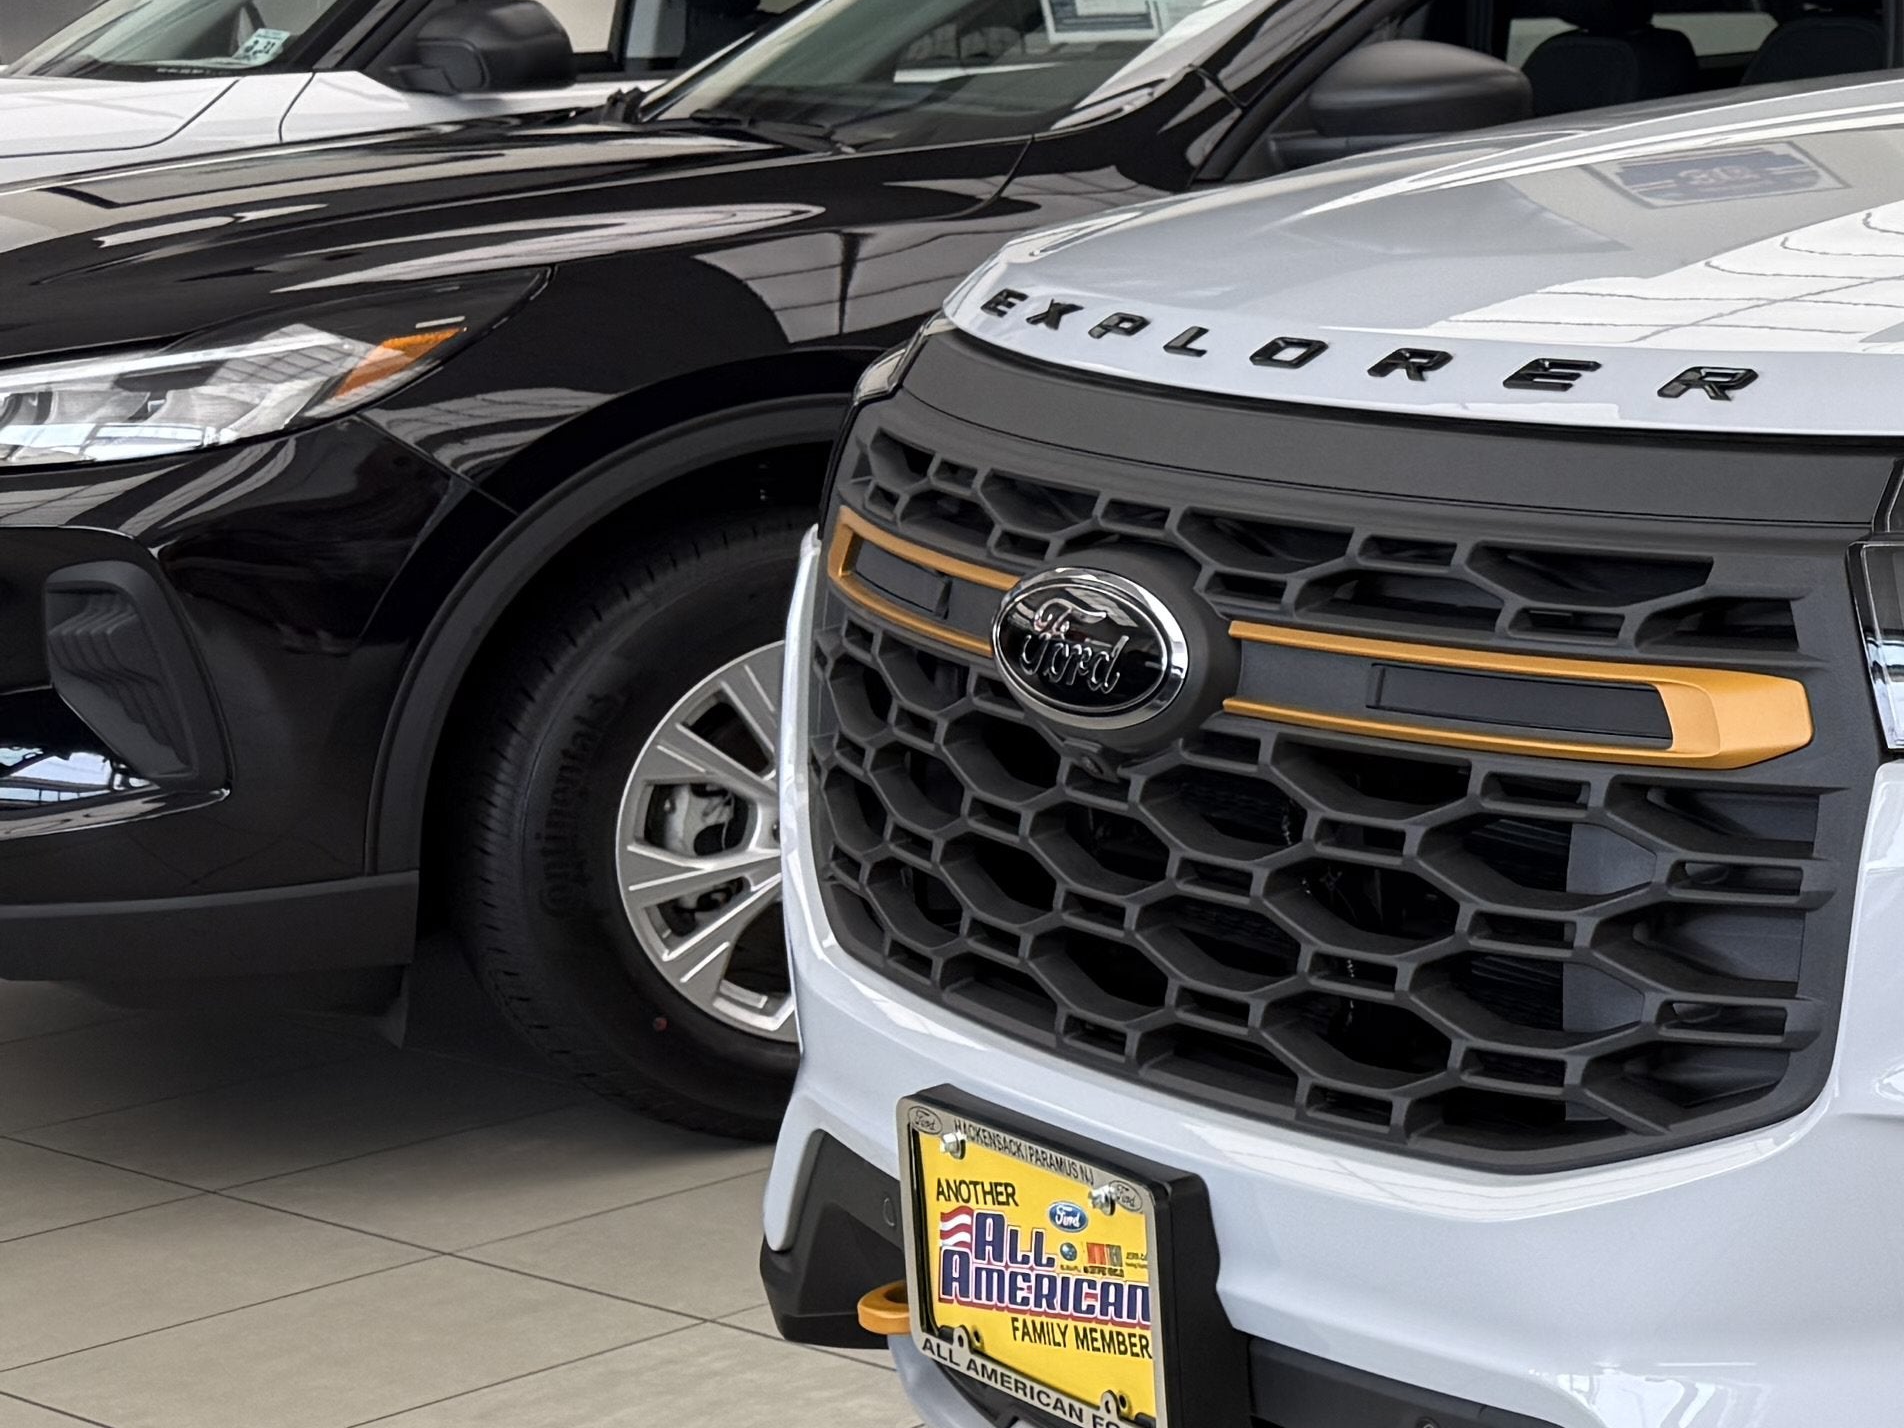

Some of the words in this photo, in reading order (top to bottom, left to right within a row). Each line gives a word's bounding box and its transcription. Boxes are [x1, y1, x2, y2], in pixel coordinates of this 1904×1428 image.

[980, 287, 1760, 403] EXPLORER
[1020, 598, 1131, 696] Ford
[936, 1177, 1019, 1207] ANOTHER
[953, 1118, 1023, 1161] HACKENSACK
[1028, 1147, 1080, 1182] PARAMUS
[1081, 1170, 1095, 1187] NJ
[940, 1246, 1152, 1326] AMERICAN
[1011, 1316, 1071, 1348] FAMILY
[1074, 1324, 1153, 1360] MEMBER
[921, 1337, 961, 1367] ALL
[966, 1357, 1084, 1424] AMERICAN
